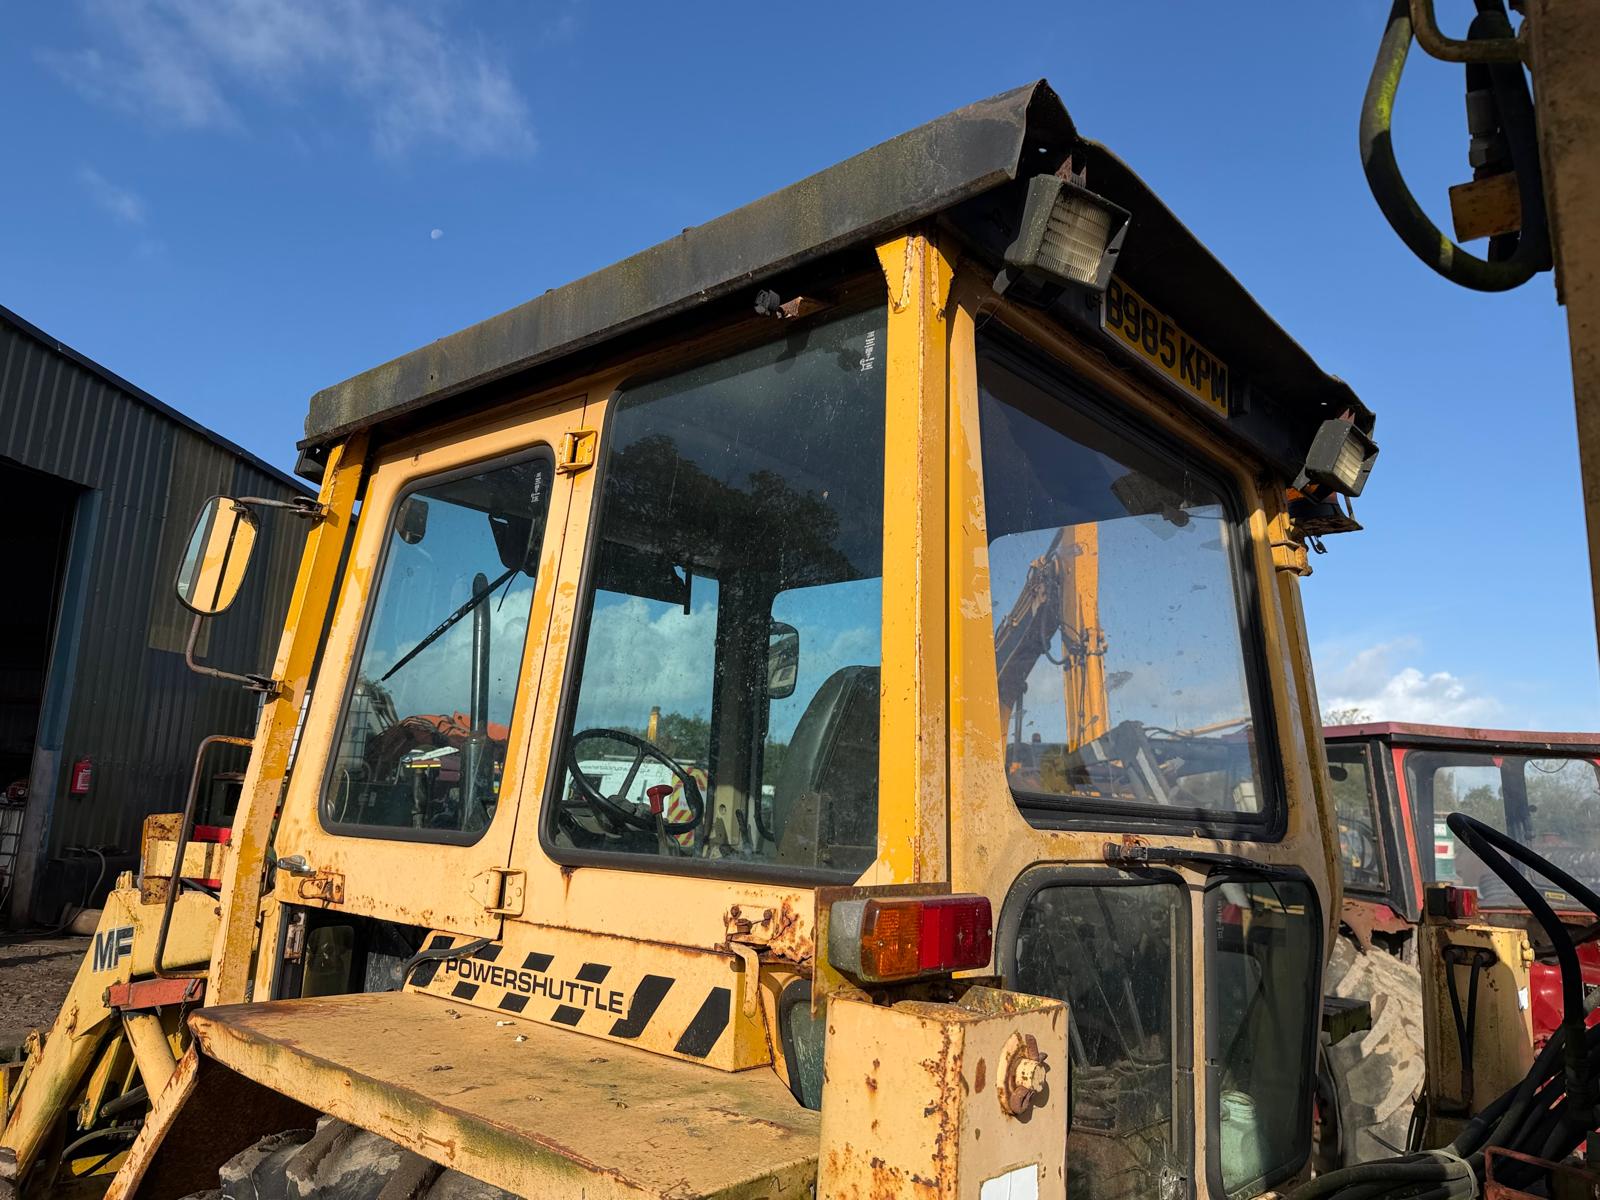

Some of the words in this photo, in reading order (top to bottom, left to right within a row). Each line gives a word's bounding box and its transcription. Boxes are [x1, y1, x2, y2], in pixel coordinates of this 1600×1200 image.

[1106, 278, 1176, 368] B985
[1180, 336, 1227, 408] KPM
[93, 927, 134, 972] MF
[445, 957, 624, 1014] POWERSHUTTLE
